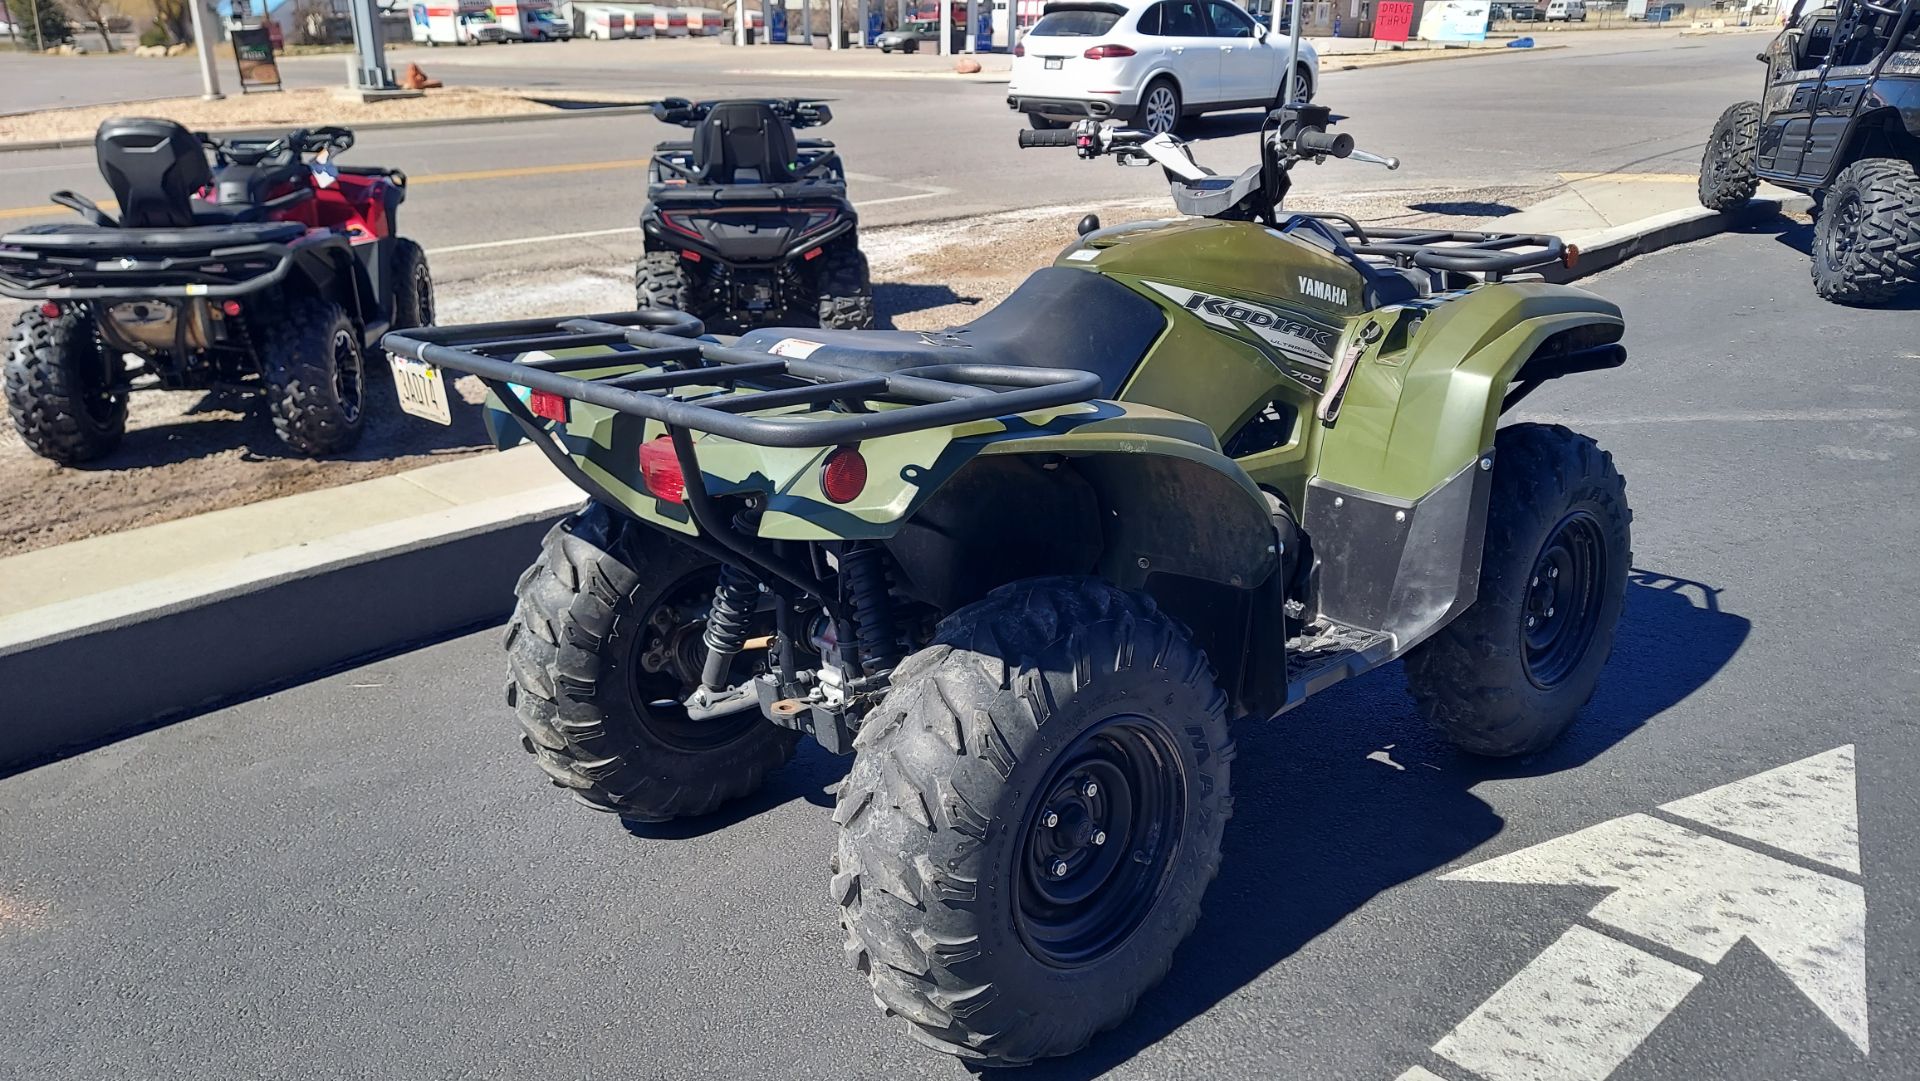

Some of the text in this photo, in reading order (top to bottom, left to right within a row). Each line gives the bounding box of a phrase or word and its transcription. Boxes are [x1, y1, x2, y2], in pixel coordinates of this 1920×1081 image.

[1382, 3, 1413, 14] DRIVE
[1378, 15, 1408, 26] THRU
[1890, 55, 1920, 67] Kawasa
[1298, 275, 1348, 307] YAMAHA
[1183, 292, 1333, 346] KODIAK
[1270, 339, 1326, 359] ULTRAMATIC
[1290, 370, 1324, 385] 700
